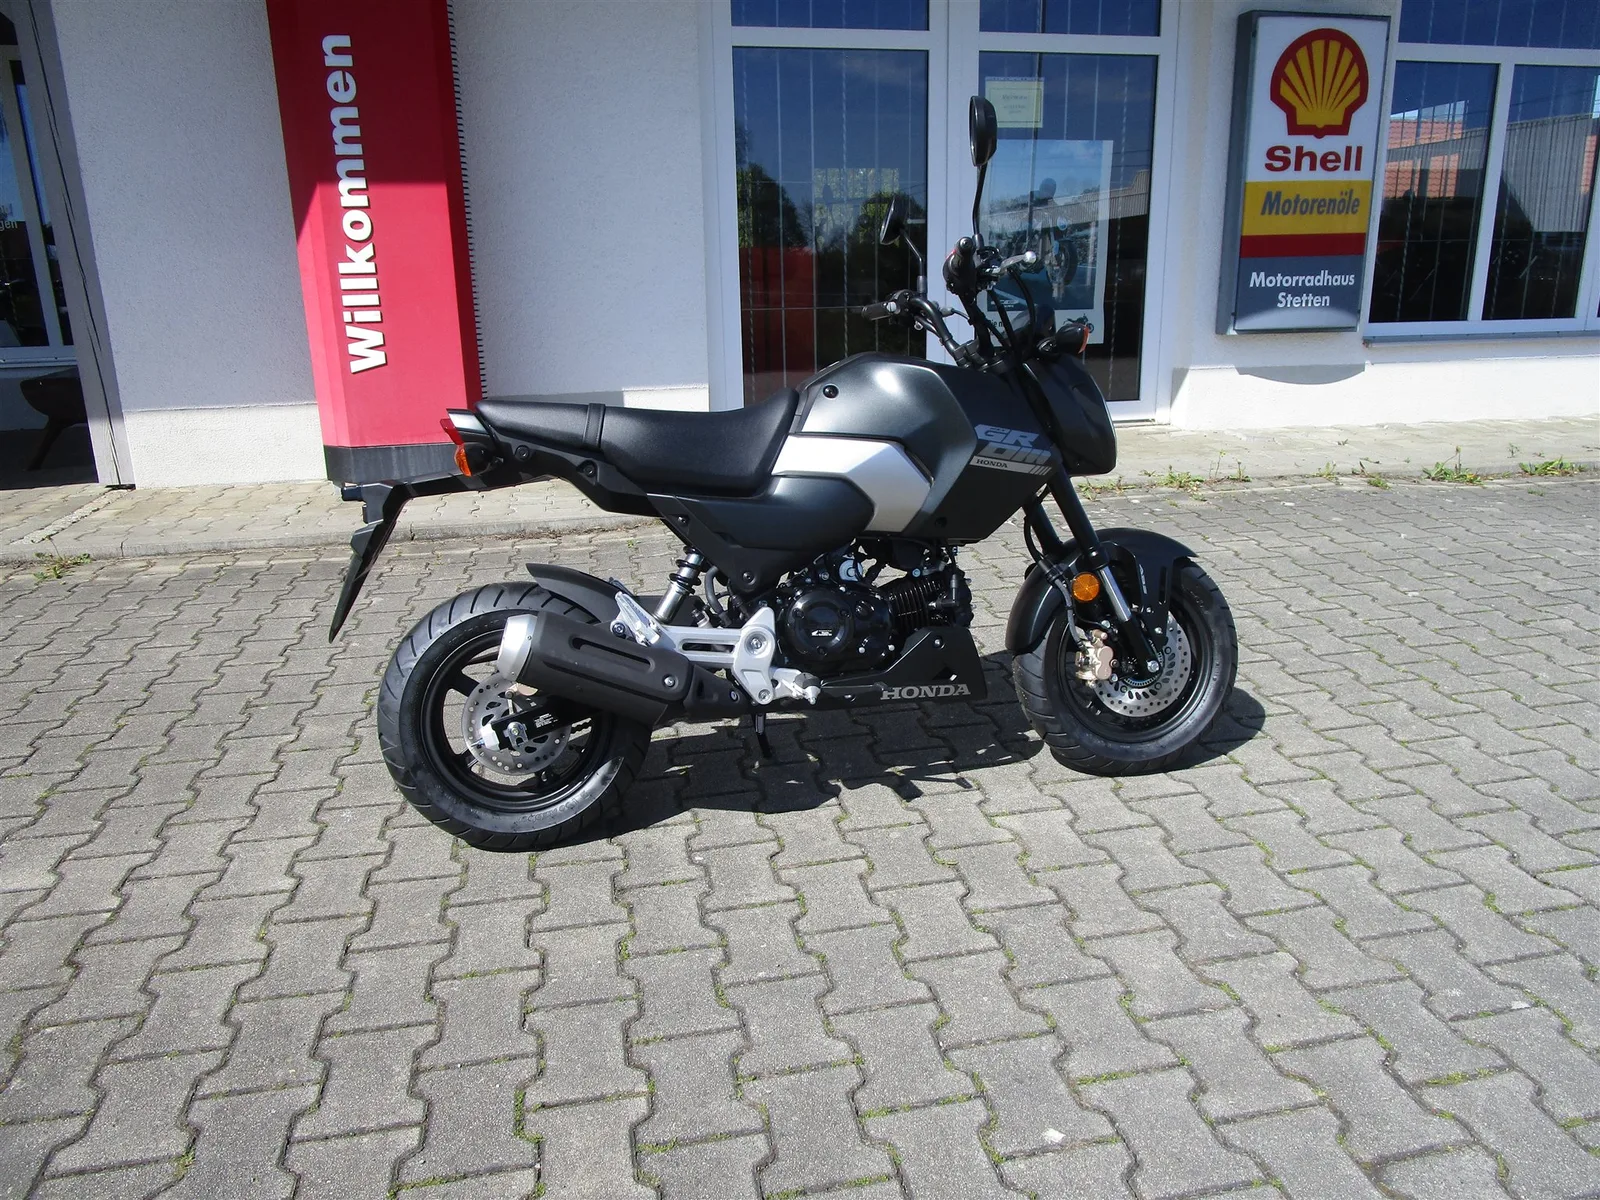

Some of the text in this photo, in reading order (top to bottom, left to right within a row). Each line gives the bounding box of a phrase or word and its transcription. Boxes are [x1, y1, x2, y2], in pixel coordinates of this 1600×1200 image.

[1265, 146, 1362, 172] Shell
[321, 33, 387, 374] Willkommen
[1261, 189, 1360, 216] Motorenöle
[1250, 270, 1355, 288] Motorradhaus
[1277, 292, 1330, 308] Stetten
[976, 459, 1008, 468] HONDA
[880, 684, 971, 700] HONDA
